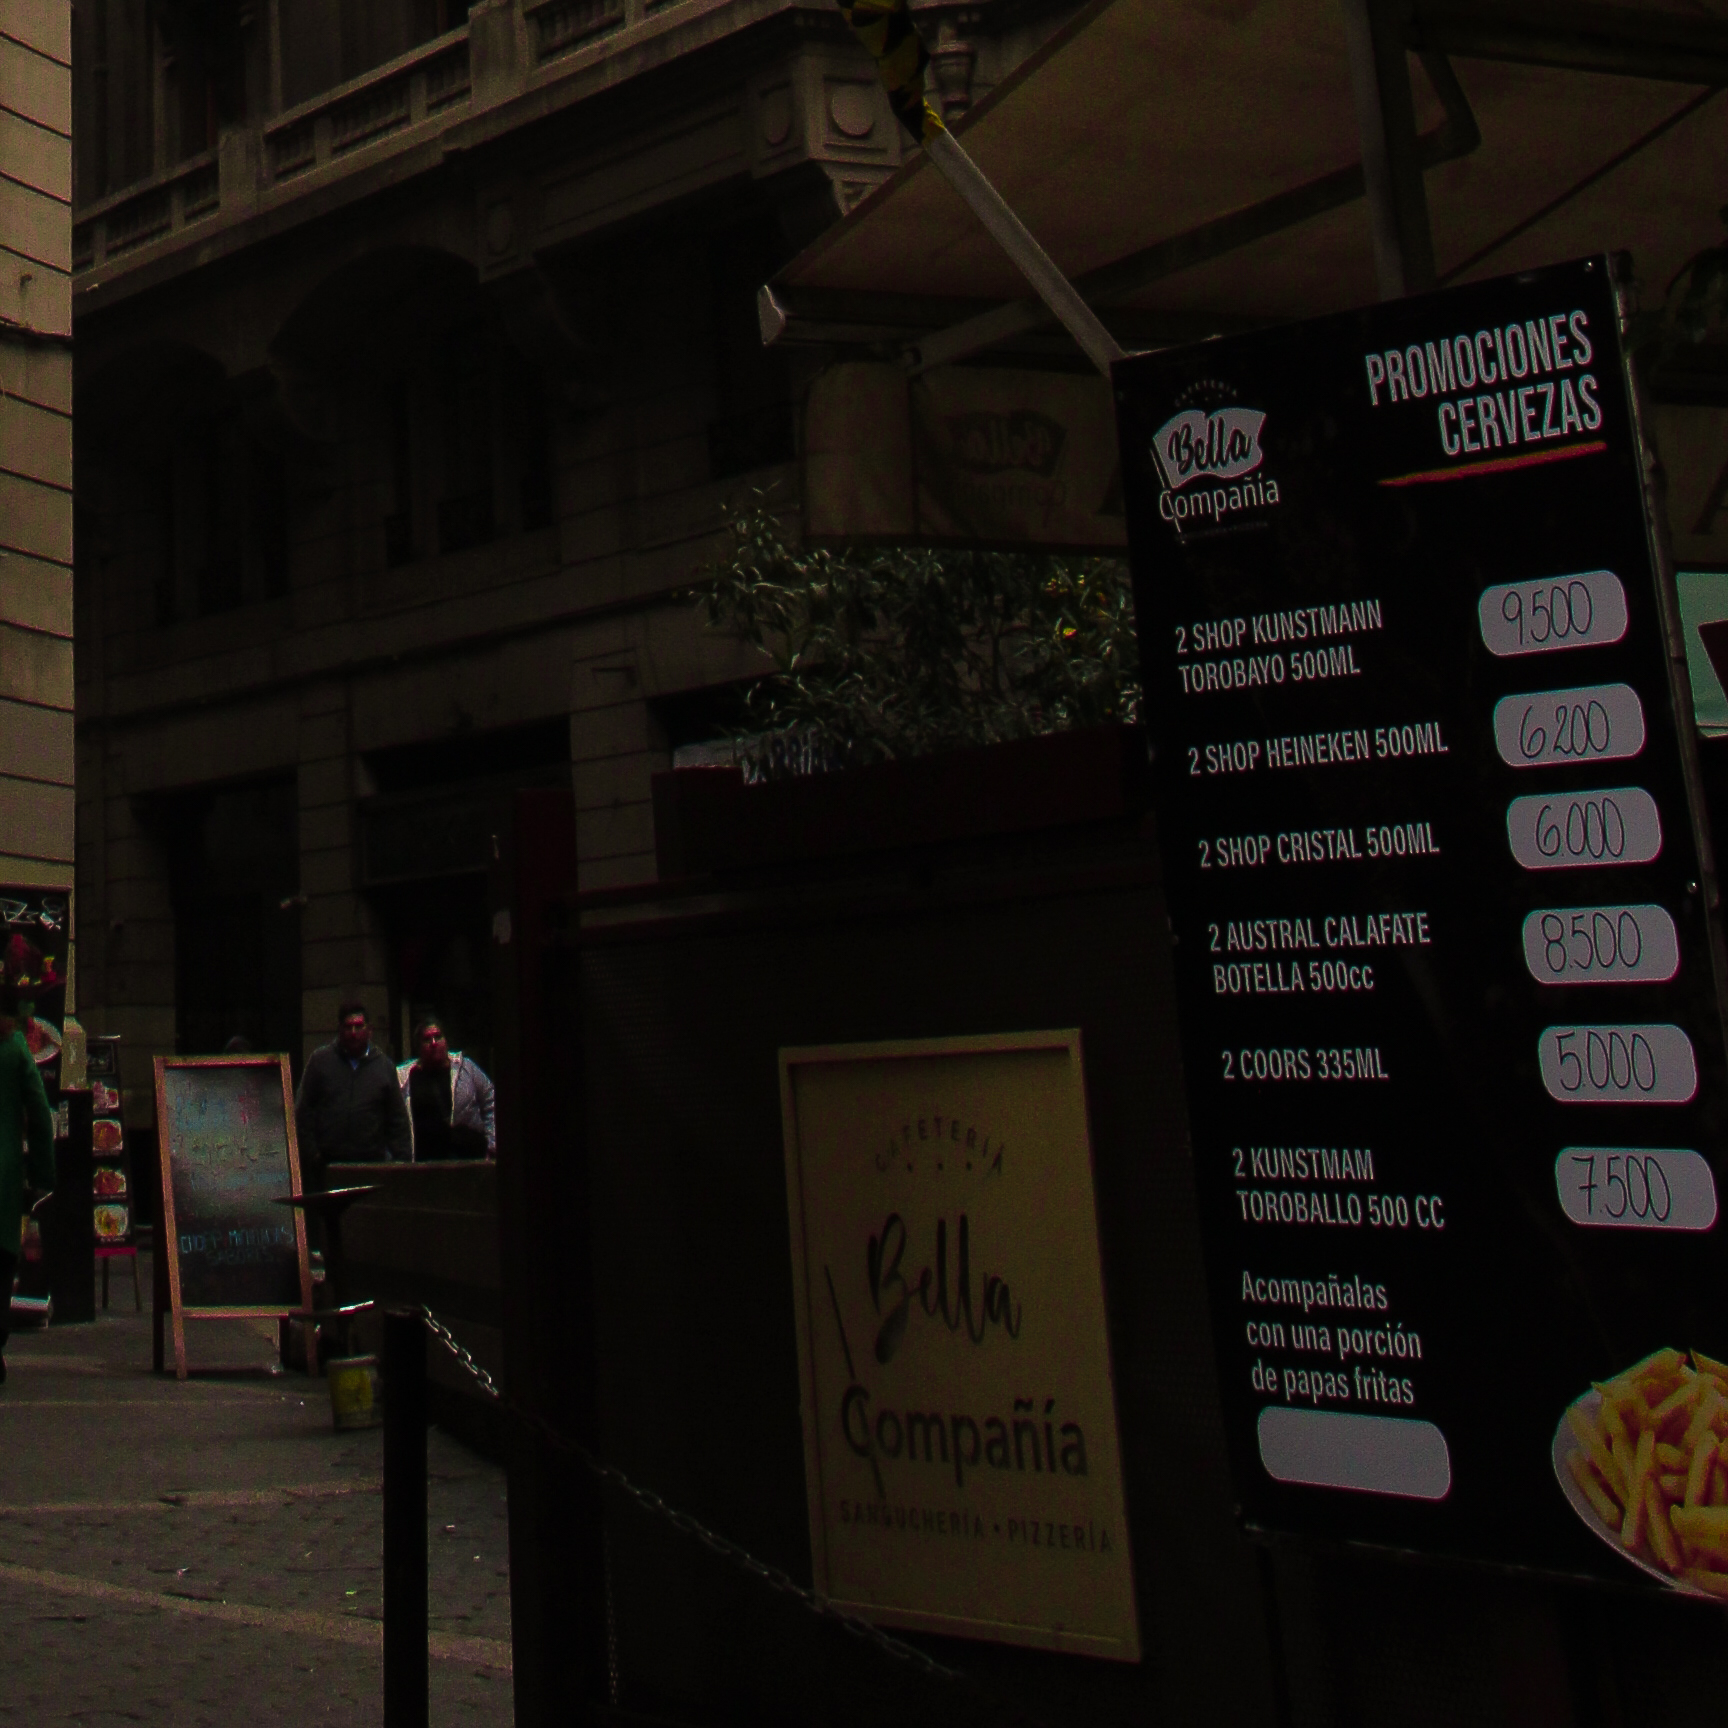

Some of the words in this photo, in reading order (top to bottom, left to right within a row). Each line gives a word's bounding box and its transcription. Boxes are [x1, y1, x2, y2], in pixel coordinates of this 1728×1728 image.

[1365, 309, 1595, 406] PROMOCIONES
[1437, 373, 1605, 456] CERVEZAS
[1168, 421, 1252, 476] Bella
[1158, 471, 1281, 523] Compañía
[1175, 626, 1188, 655] 2
[1192, 615, 1247, 653] SHOP
[1252, 598, 1384, 643] KUNSTMANN
[1501, 579, 1594, 645] 9.500
[1178, 654, 1286, 694] TOROBAYO
[1290, 644, 1361, 680] 500ML
[1188, 746, 1201, 777] 2
[1204, 739, 1261, 774] SHOP
[1265, 729, 1371, 769] HEINEKEN
[1375, 721, 1450, 757] 500ML
[1518, 700, 1611, 759] 6.200
[1198, 839, 1212, 869] 2
[1216, 834, 1273, 867] SHOP
[1277, 828, 1363, 865] CRISTAL
[1366, 822, 1440, 858] 500ML
[1535, 798, 1625, 859] 6.000
[1208, 924, 1221, 953] 2
[1225, 915, 1320, 952] AUSTRAL
[1323, 911, 1432, 946] CALAFATE
[1540, 910, 1642, 974] 8.500
[1212, 961, 1304, 995] BOTELLA
[1309, 959, 1375, 992] 500cc
[1222, 1050, 1235, 1081] 2
[1238, 1048, 1312, 1081] COORS
[1316, 1046, 1390, 1082] 335ML
[1554, 1031, 1657, 1092] 5.000
[1233, 1147, 1247, 1178] 2
[1251, 1148, 1374, 1181] KUNSTMAM
[1569, 1154, 1673, 1224] 7.500
[1235, 1190, 1362, 1228] TOROBALLO
[1368, 1193, 1409, 1229] 500
[1414, 1195, 1446, 1230] CC
[865, 1211, 1025, 1366] Bella
[1241, 1270, 1389, 1313] Acompañalas
[1245, 1323, 1286, 1349] con
[1290, 1325, 1331, 1354] una
[1337, 1321, 1423, 1360] porción
[1251, 1360, 1278, 1394] de
[1283, 1369, 1349, 1406] papas
[1353, 1367, 1416, 1407] fritas
[838, 1382, 1089, 1489] Compañía
